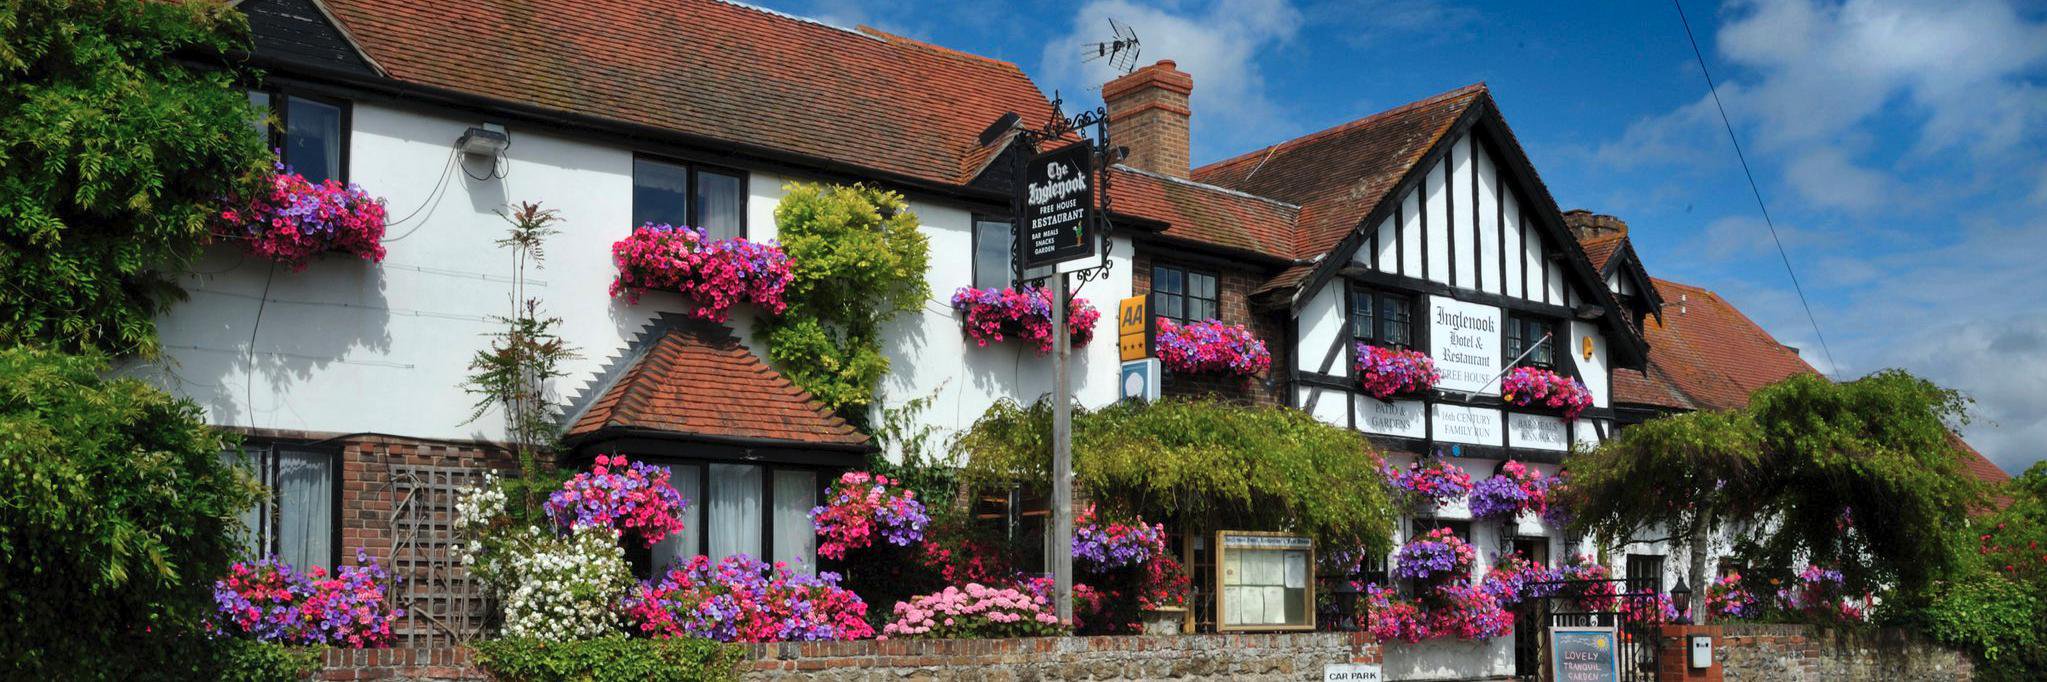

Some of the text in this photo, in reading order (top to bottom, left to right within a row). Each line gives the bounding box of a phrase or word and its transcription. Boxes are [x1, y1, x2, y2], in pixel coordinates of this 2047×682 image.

[1047, 161, 1069, 180] The
[1028, 171, 1087, 206] Inglenook
[1040, 199, 1077, 215] FREE HOUSE
[1032, 208, 1084, 229] RESTAURANT
[1032, 228, 1059, 240] BAR MEALS
[1035, 237, 1055, 247] SNACKS
[1034, 245, 1056, 255] GARDEN
[1122, 304, 1143, 327] AA
[1436, 305, 1495, 333] Inglenook
[1449, 331, 1483, 350] Hotel &
[1443, 347, 1490, 368] Restaurant
[1464, 371, 1490, 384] HOUSE
[1375, 402, 1407, 417] PATIO &
[1371, 416, 1411, 431] GARDENS
[1456, 412, 1490, 425] CENTURY
[1444, 424, 1490, 438] FAMILY RUN
[1565, 651, 1599, 661] LOVELY
[1329, 672, 1377, 680] CAR PARK
